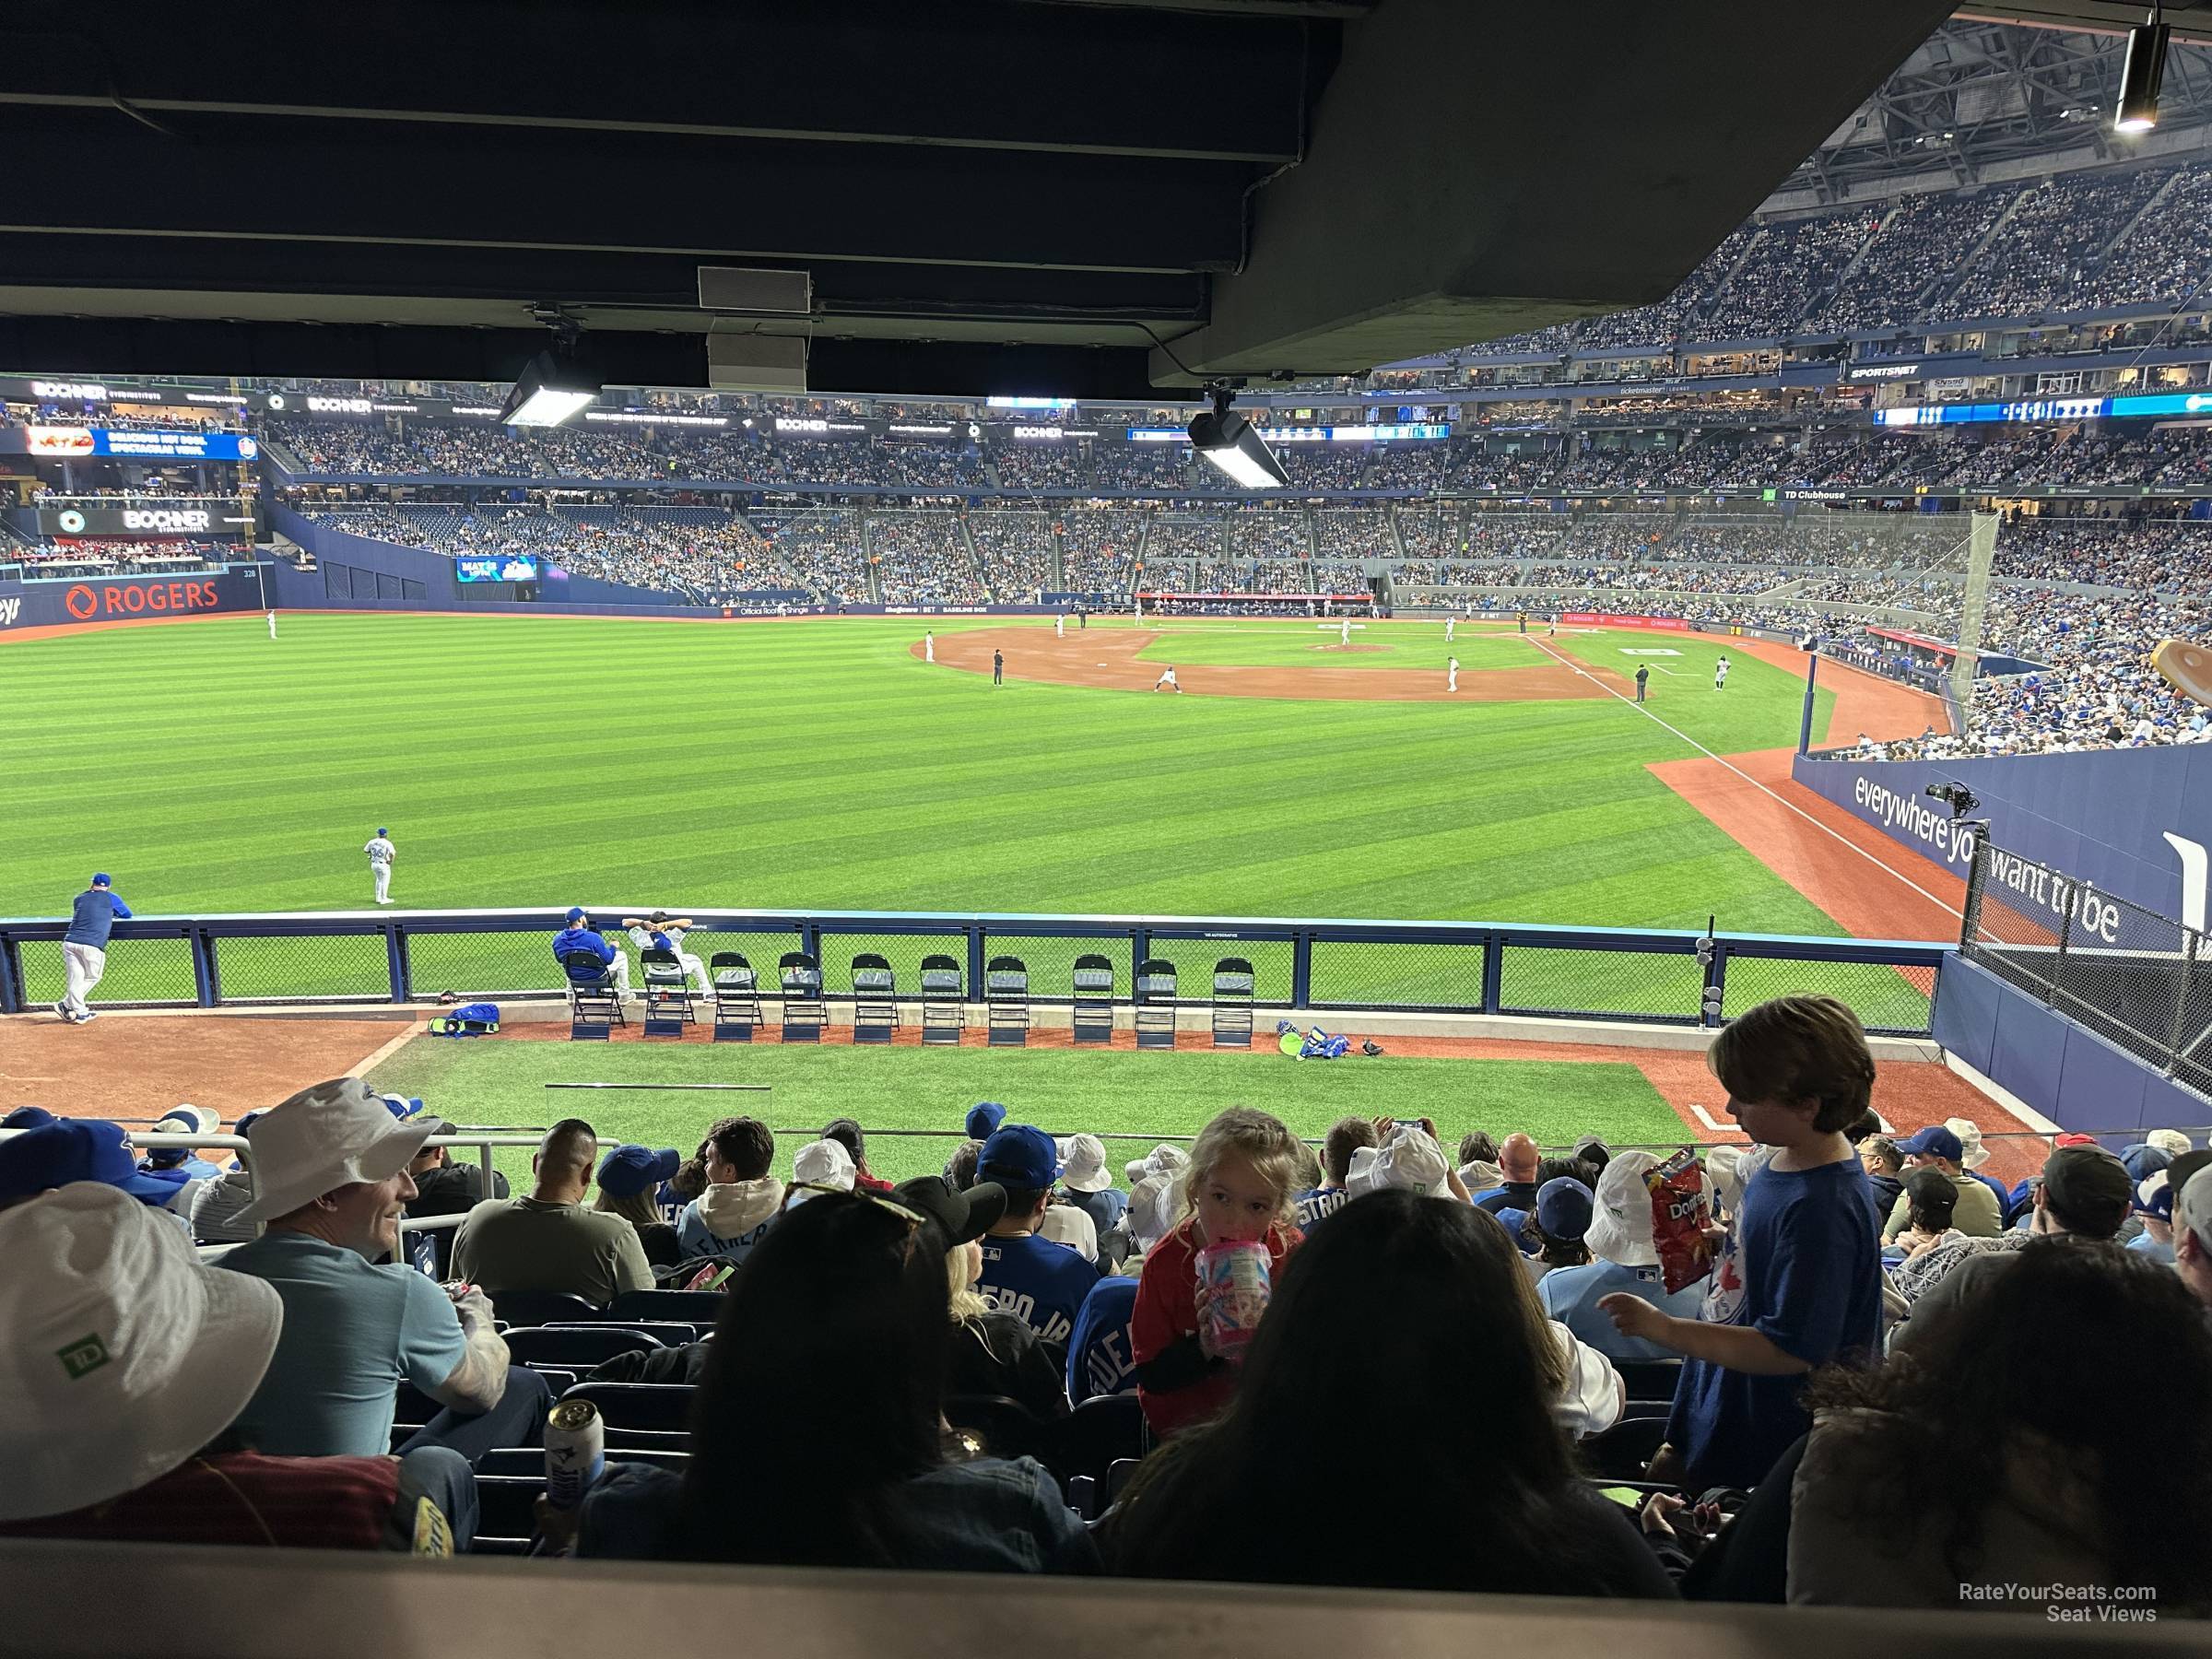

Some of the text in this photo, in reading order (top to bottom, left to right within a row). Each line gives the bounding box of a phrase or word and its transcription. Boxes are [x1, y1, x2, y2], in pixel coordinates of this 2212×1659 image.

[1851, 365, 1919, 379] SPORTSNET
[31, 382, 107, 400] BOCHNER
[1620, 386, 1663, 394] ticketmaster
[307, 396, 371, 413] BOCHNER
[776, 418, 828, 431] BOCHNER
[1014, 427, 1063, 438] BOCHNER
[1784, 491, 1846, 500] TD Clubhouse
[124, 510, 210, 530] BOCHNER
[243, 570, 256, 579] 328
[103, 581, 218, 615] ROGERS
[740, 607, 762, 616] Official
[786, 606, 808, 615] Shingle
[1855, 775, 1947, 850] everywhere
[1947, 821, 1974, 864] yo
[1990, 847, 2045, 906] want
[2080, 880, 2121, 944] be
[64, 1342, 103, 1371] TD
